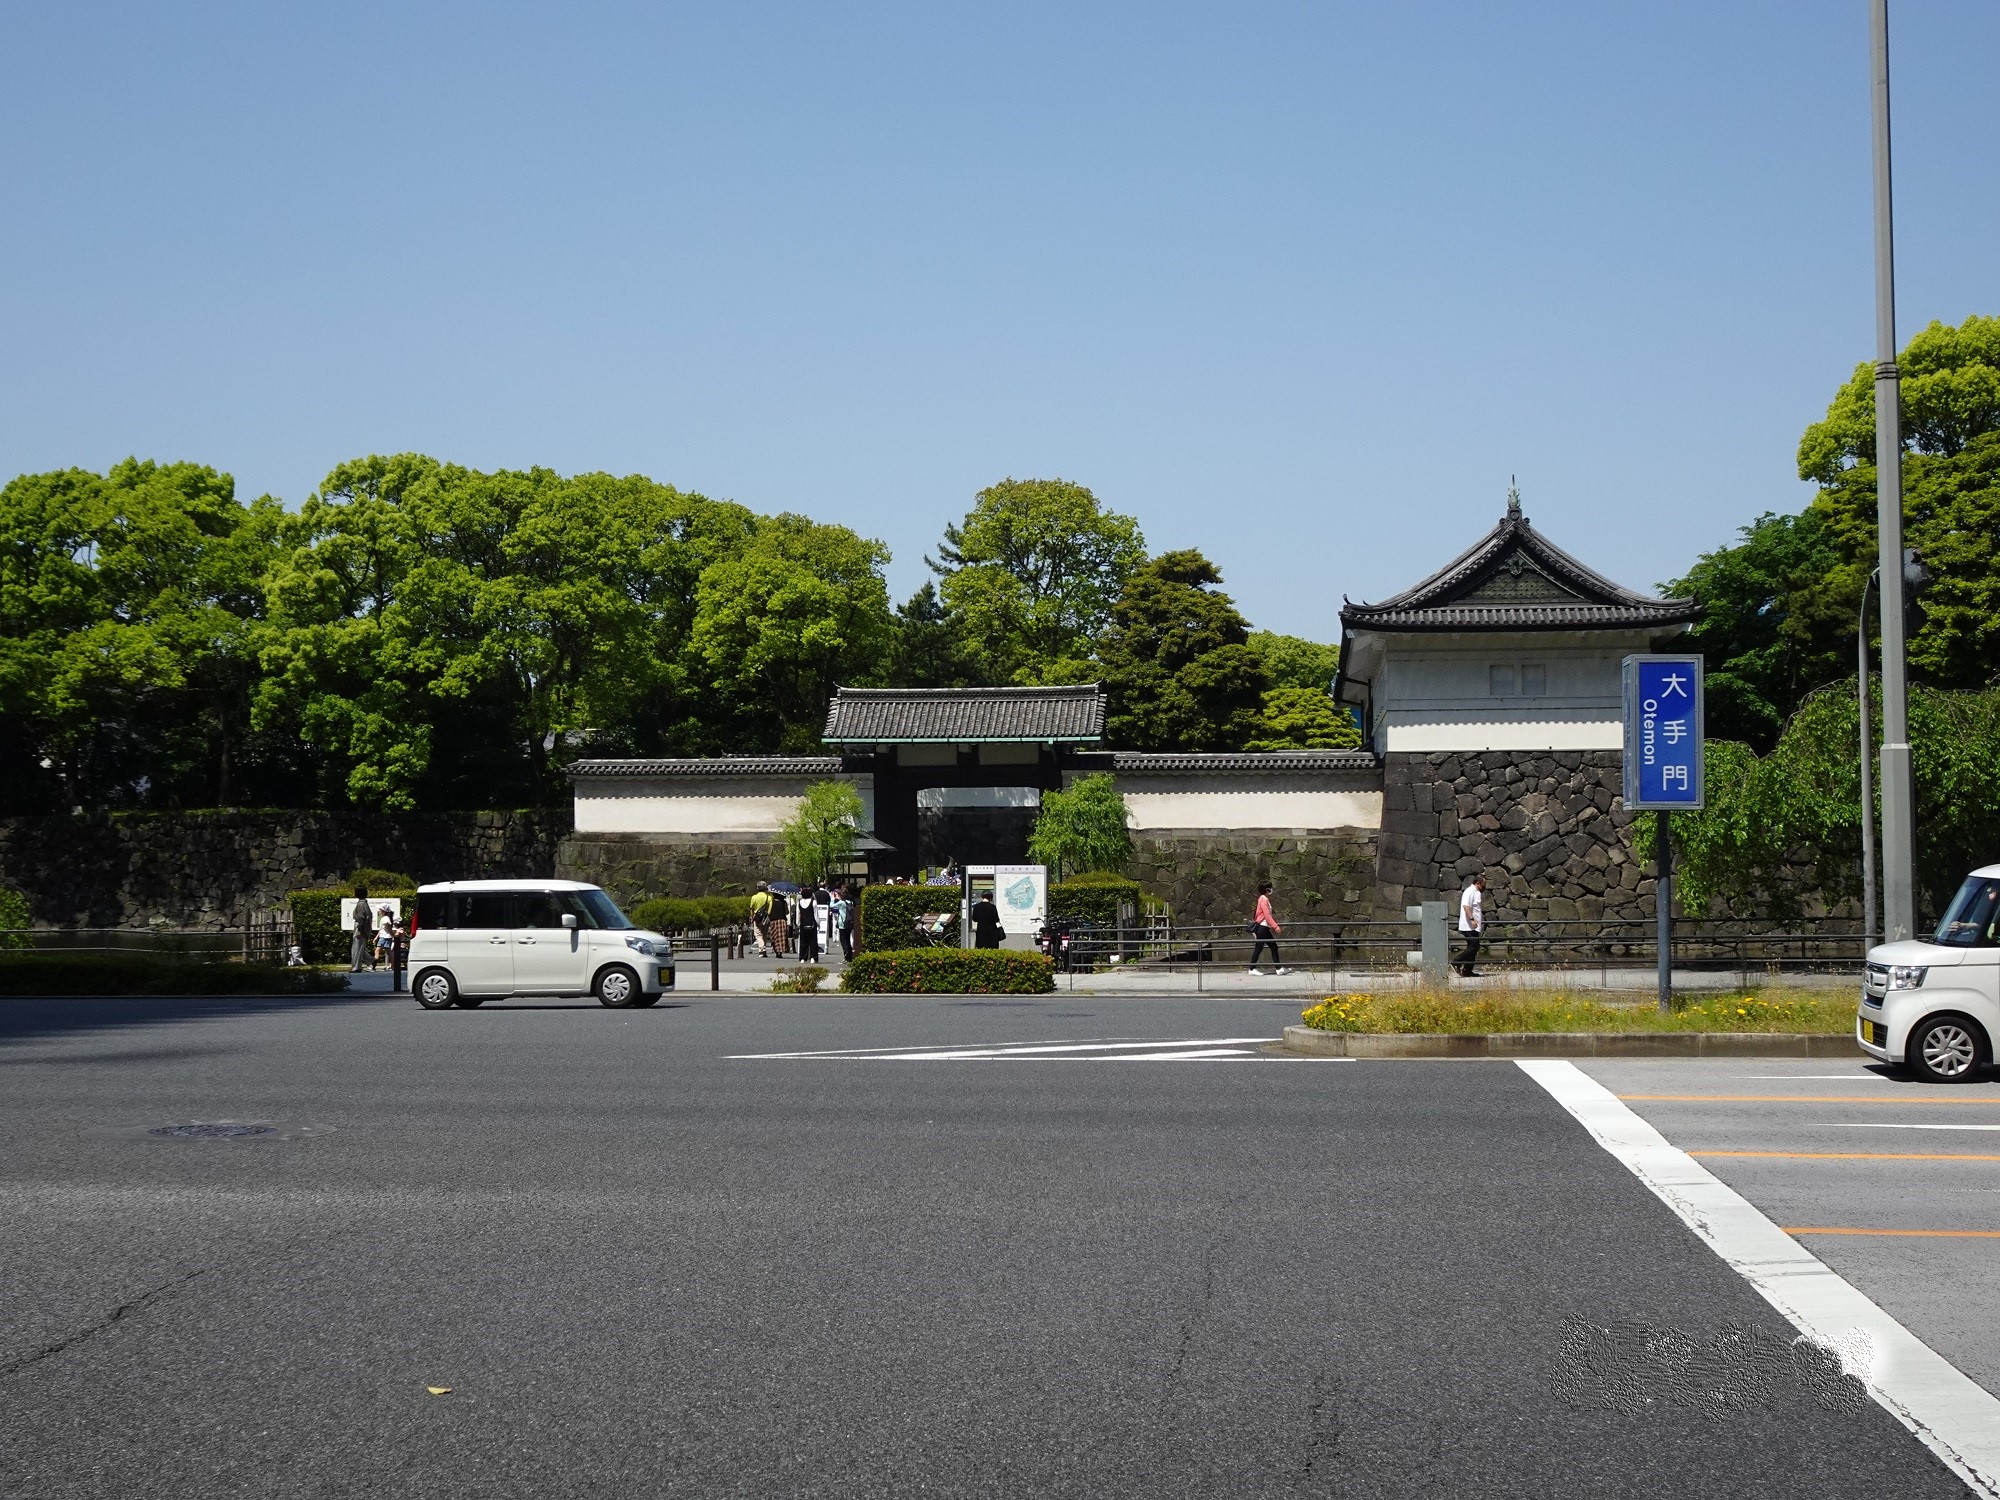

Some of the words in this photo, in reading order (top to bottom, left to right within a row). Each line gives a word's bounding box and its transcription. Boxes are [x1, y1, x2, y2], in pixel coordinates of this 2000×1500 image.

[1643, 699, 1657, 765] Otemon
[1661, 673, 1687, 790] 大手門
